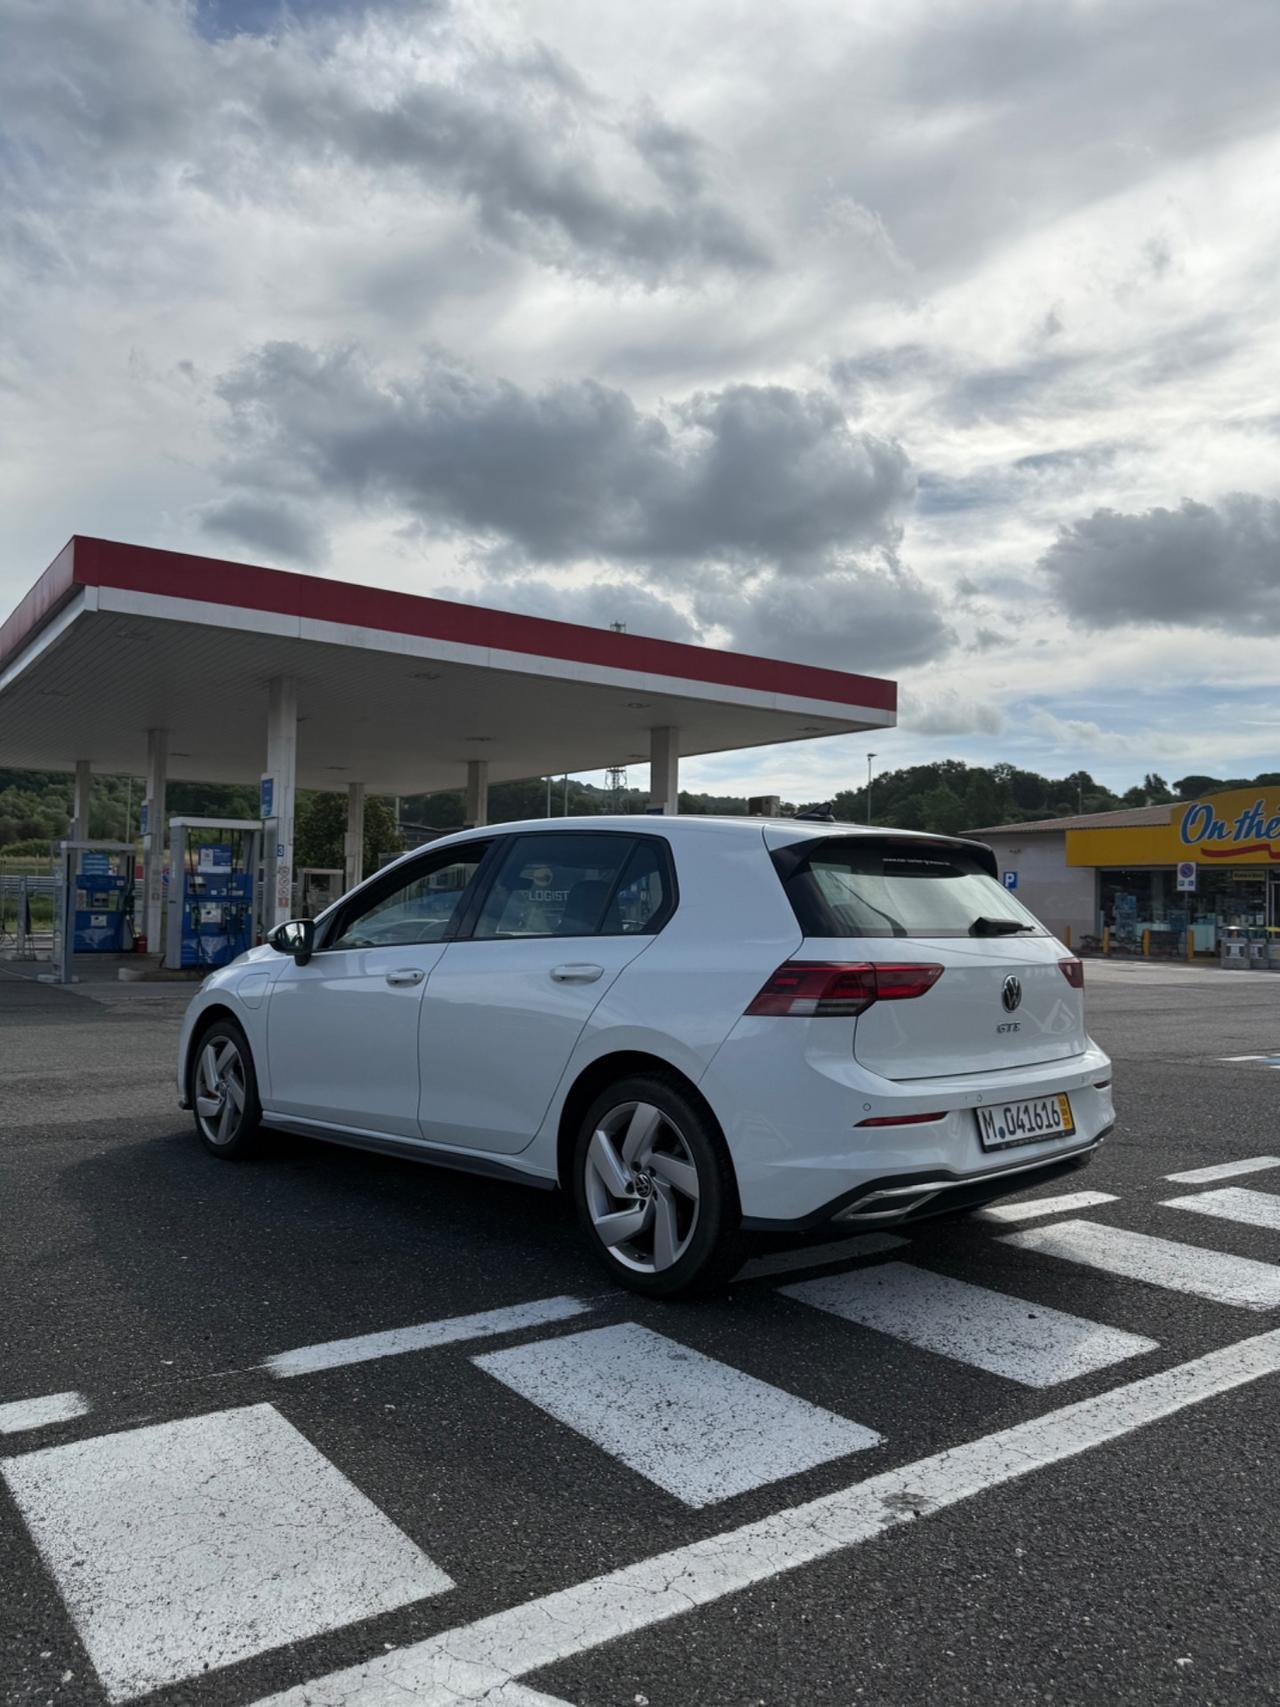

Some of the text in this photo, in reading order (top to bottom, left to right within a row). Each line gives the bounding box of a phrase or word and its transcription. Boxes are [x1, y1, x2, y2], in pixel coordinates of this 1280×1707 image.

[1180, 799, 1280, 845] On the
[1005, 873, 1015, 887] P
[996, 1022, 1022, 1033] GTE
